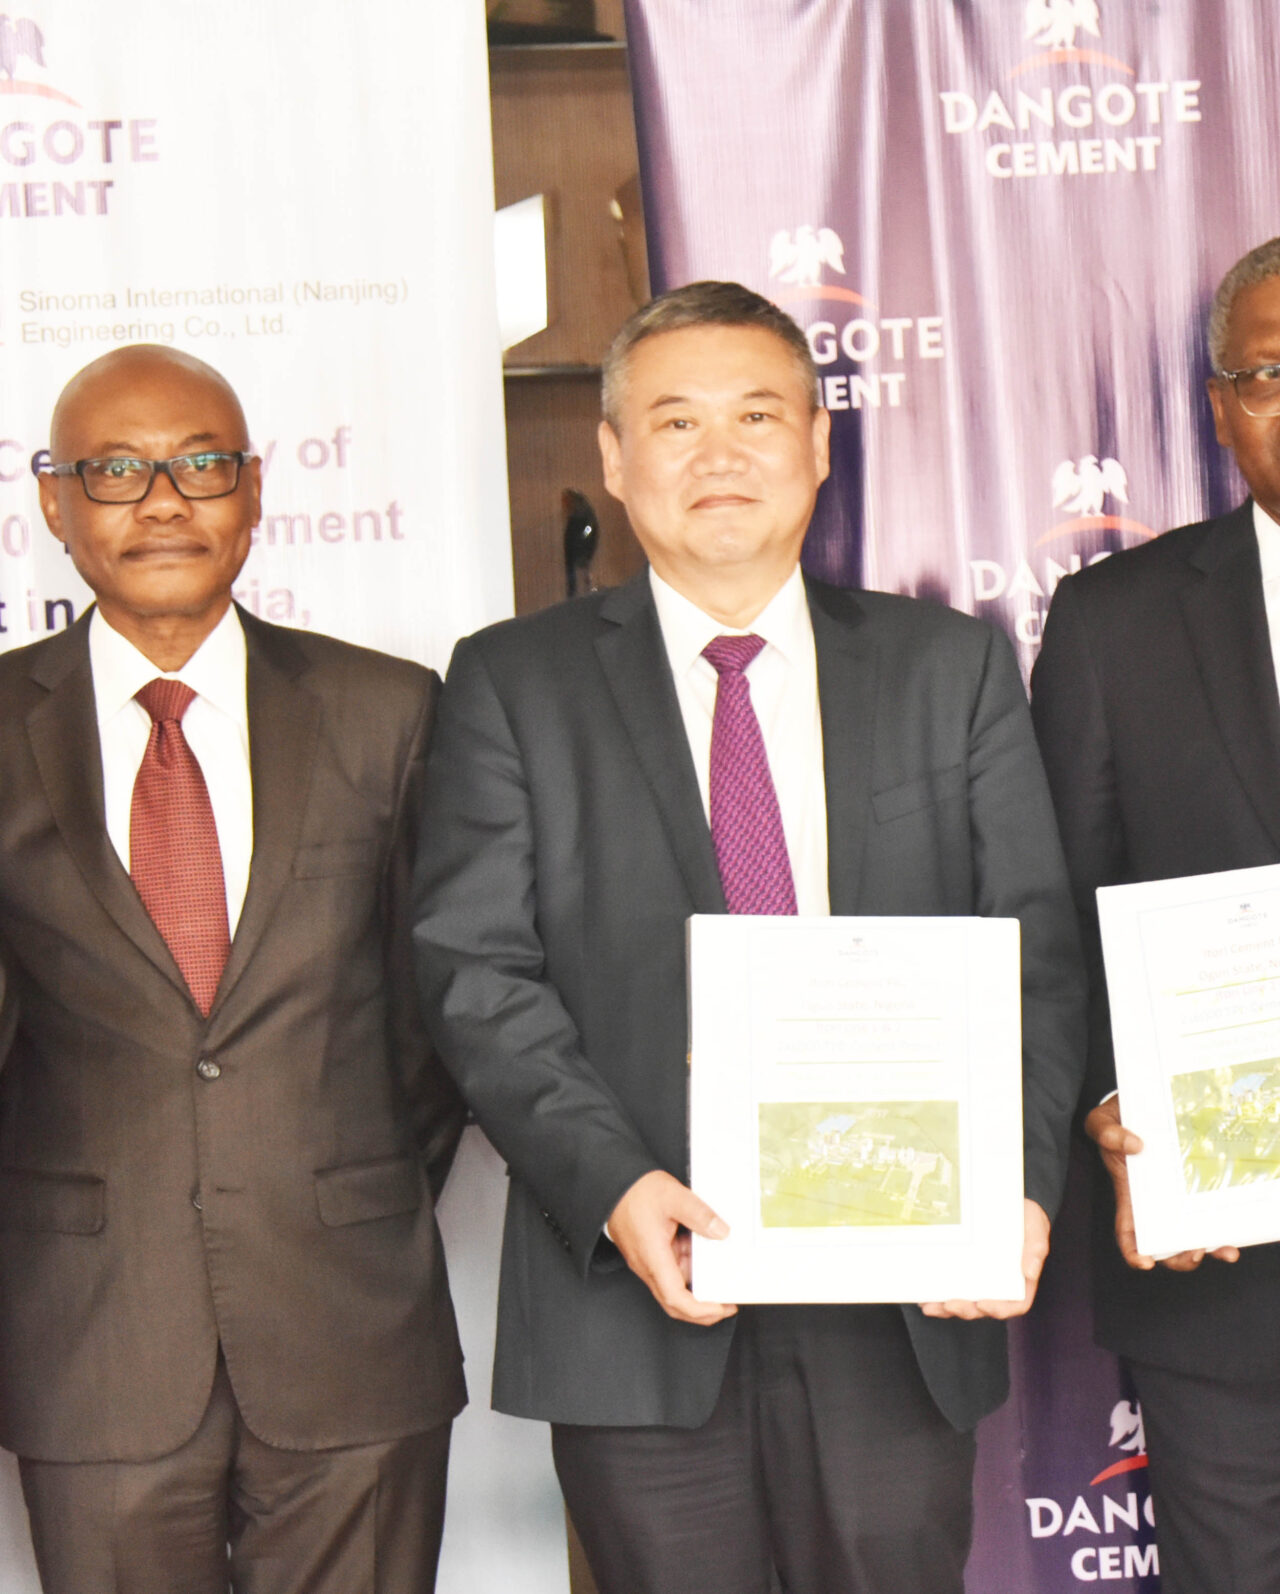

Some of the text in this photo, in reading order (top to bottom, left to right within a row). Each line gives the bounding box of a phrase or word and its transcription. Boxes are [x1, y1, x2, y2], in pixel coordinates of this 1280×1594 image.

[939, 80, 1201, 133] DANGOTE
[985, 136, 1161, 178] CEMENT
[19, 277, 409, 313] Sinoma International (Nanjing)
[21, 318, 176, 349] Engineering
[184, 315, 236, 339] Co.,
[297, 425, 352, 470] of
